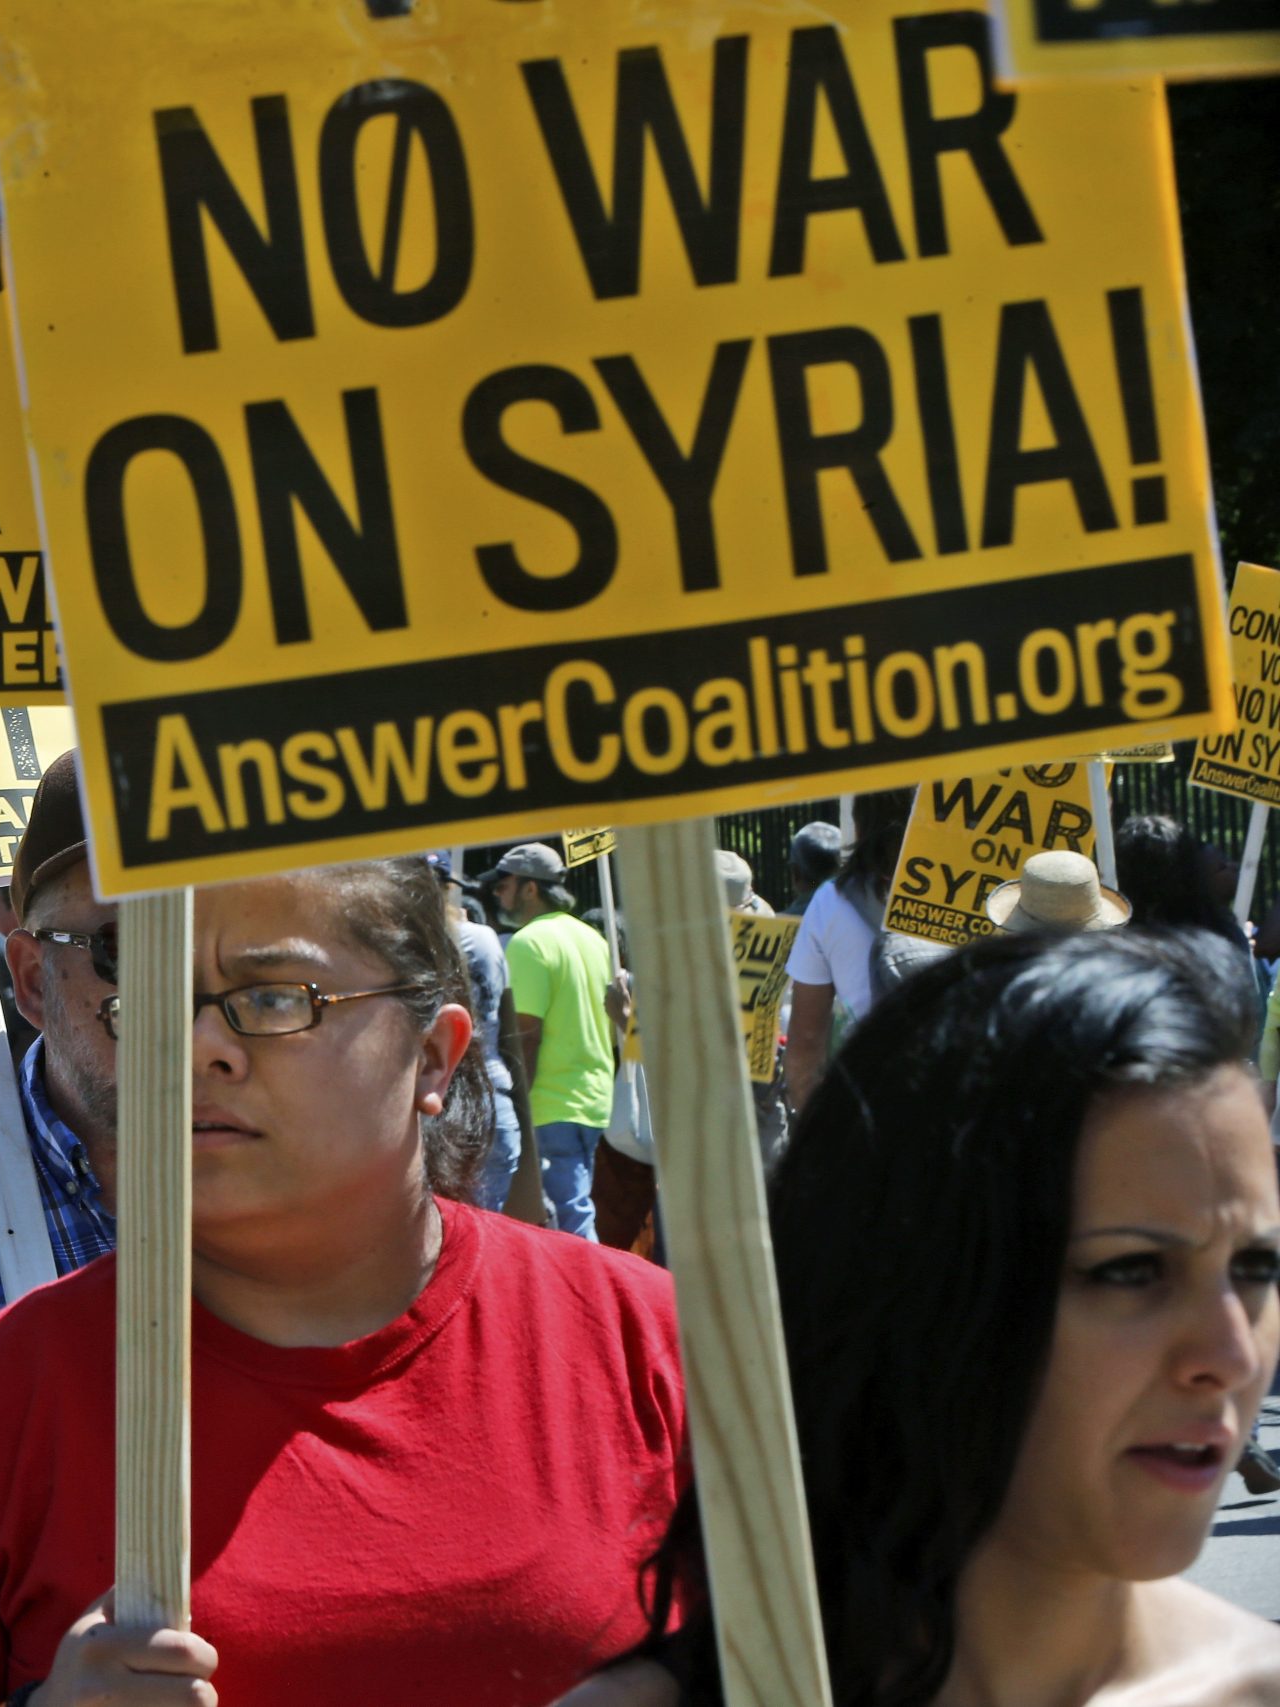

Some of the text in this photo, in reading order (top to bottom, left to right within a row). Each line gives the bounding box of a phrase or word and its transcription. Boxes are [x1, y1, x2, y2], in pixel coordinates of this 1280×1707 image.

[519, 10, 1046, 301] WAR
[84, 286, 1169, 663] ON SYRIA!
[1229, 606, 1280, 647] CON
[147, 611, 1184, 842] AnswerCoalition.org
[1248, 732, 1280, 775] SY
[932, 778, 1092, 851] WAR
[971, 838, 1022, 871] ON
[889, 915, 977, 945] ANSWERCO
[891, 898, 965, 930] ANSWER
